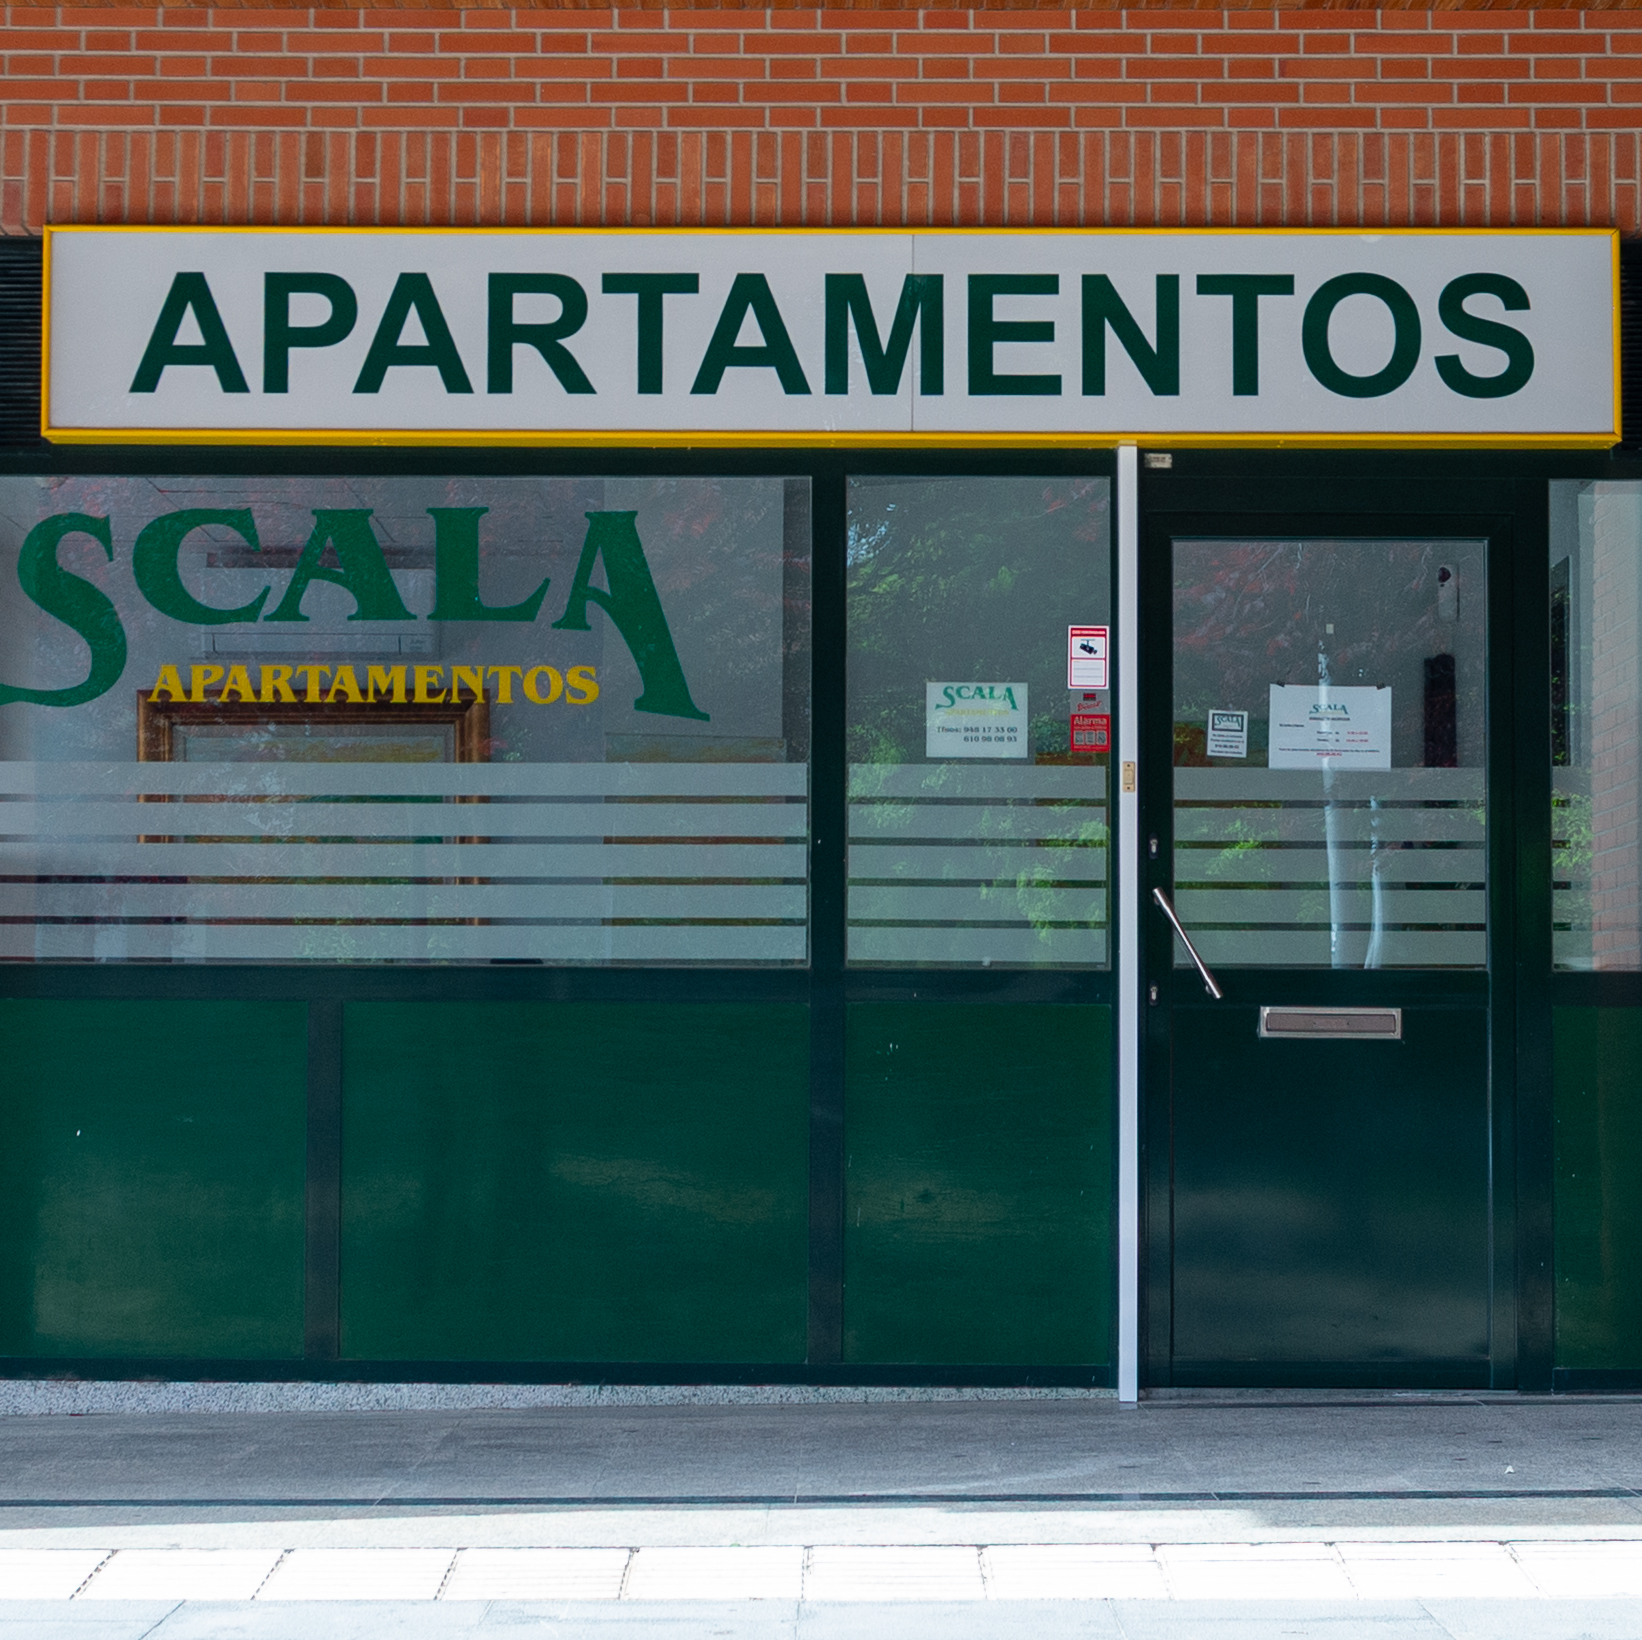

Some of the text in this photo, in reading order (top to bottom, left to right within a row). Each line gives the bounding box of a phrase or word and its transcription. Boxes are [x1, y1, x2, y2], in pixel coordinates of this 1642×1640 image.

[128, 269, 1535, 398] APARTAMENTOS
[147, 664, 600, 706] APARTAMENTOS
[935, 685, 1019, 711] SCALA
[1074, 716, 1107, 725] Alarma
[1214, 715, 1241, 727] SCALA
